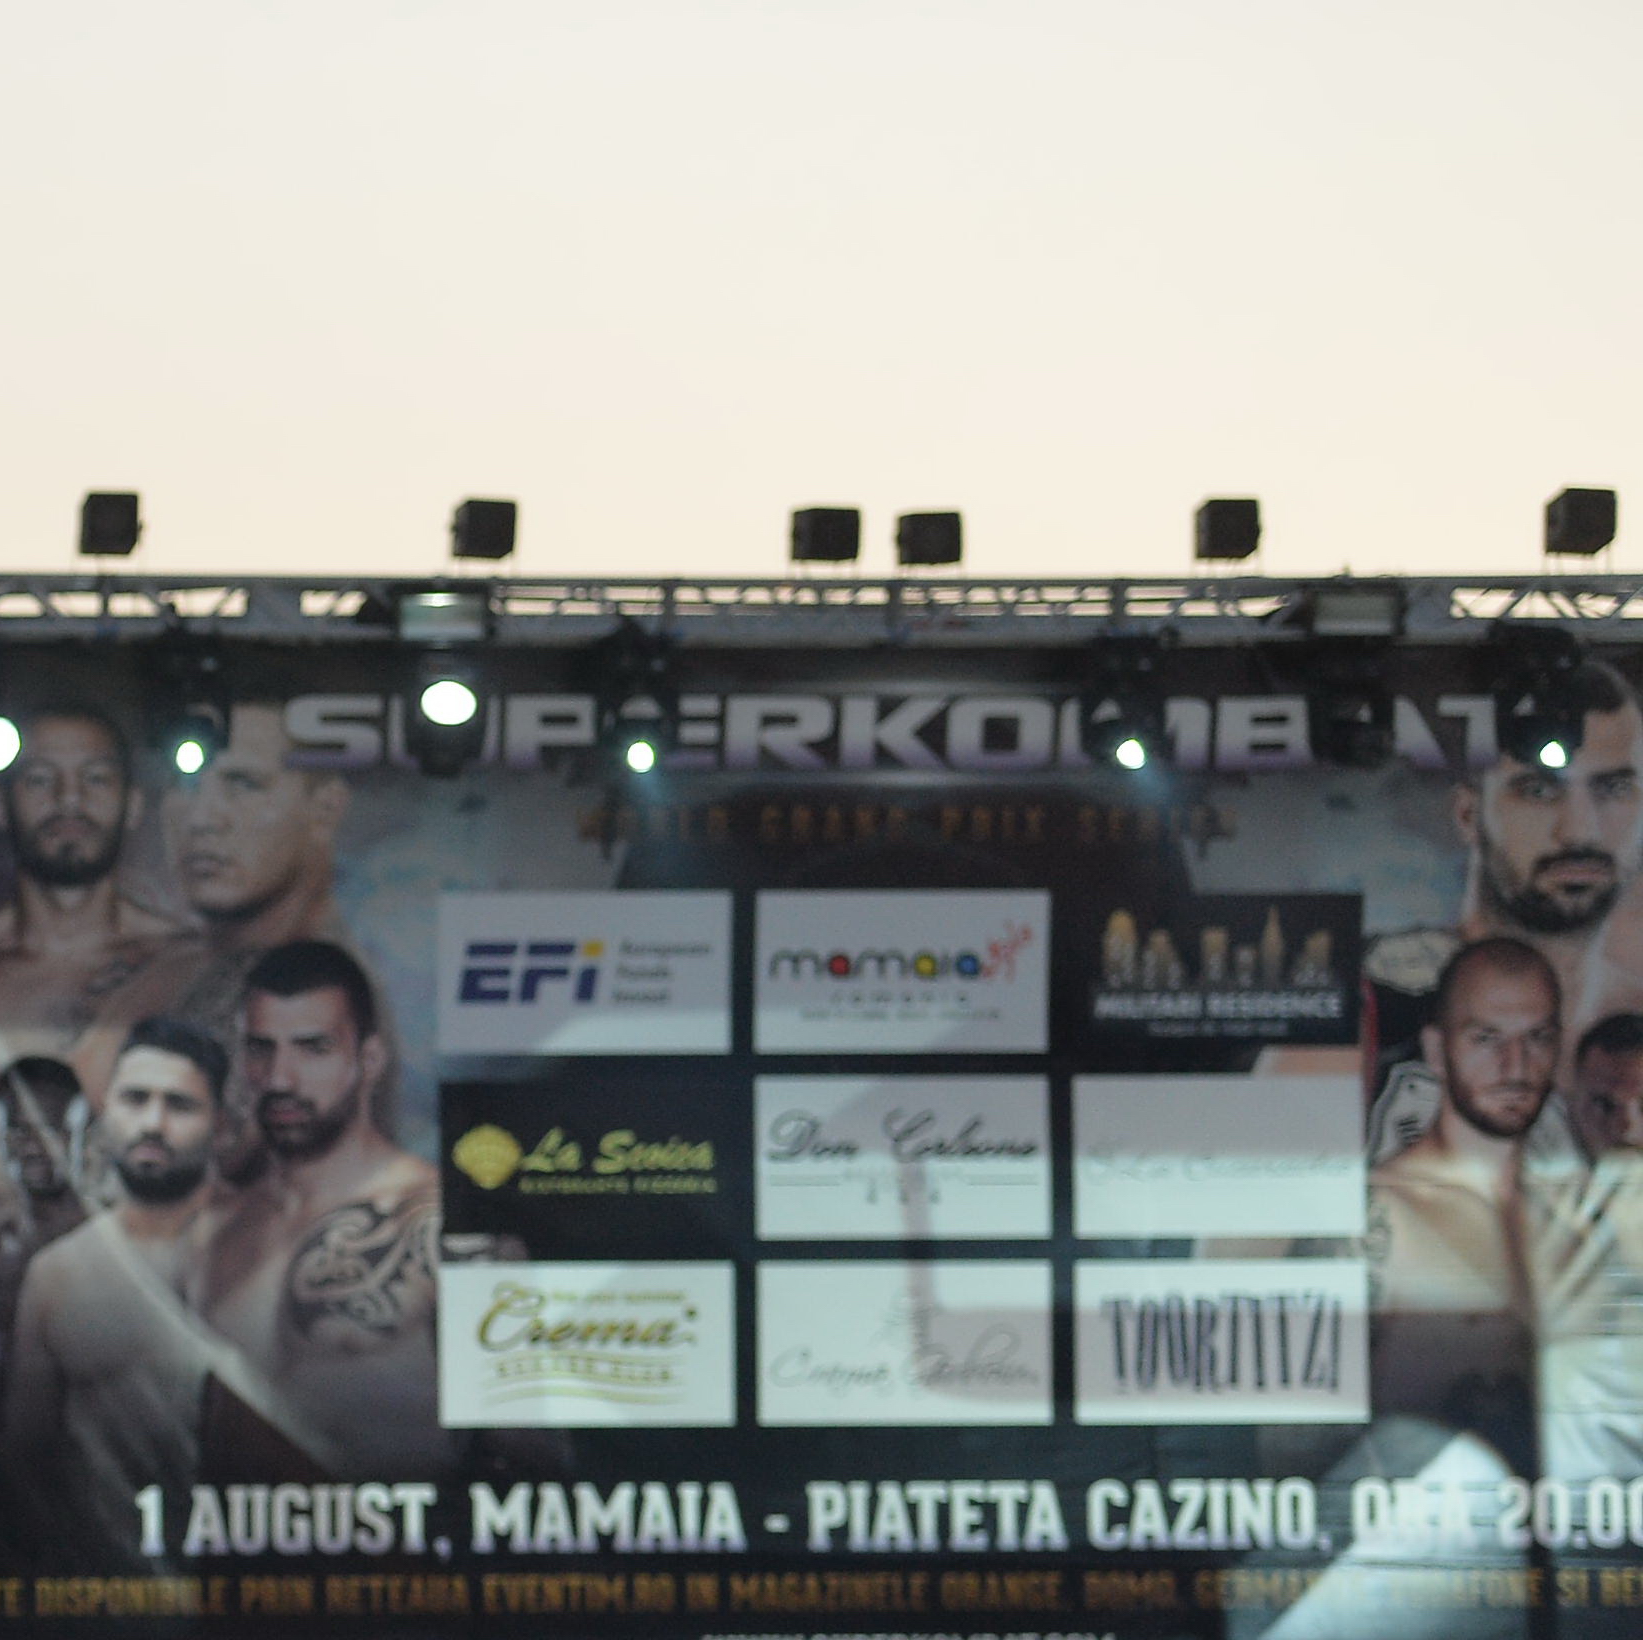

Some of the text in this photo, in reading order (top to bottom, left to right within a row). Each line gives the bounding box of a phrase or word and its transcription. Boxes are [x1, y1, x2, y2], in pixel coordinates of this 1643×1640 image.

[135, 1484, 164, 1556] 1
[182, 1482, 453, 1561] AUGUST,
[469, 1481, 748, 1553] MAMAIA
[807, 1480, 1070, 1554] PIATETA
[1086, 1477, 1333, 1557] CAZINO,
